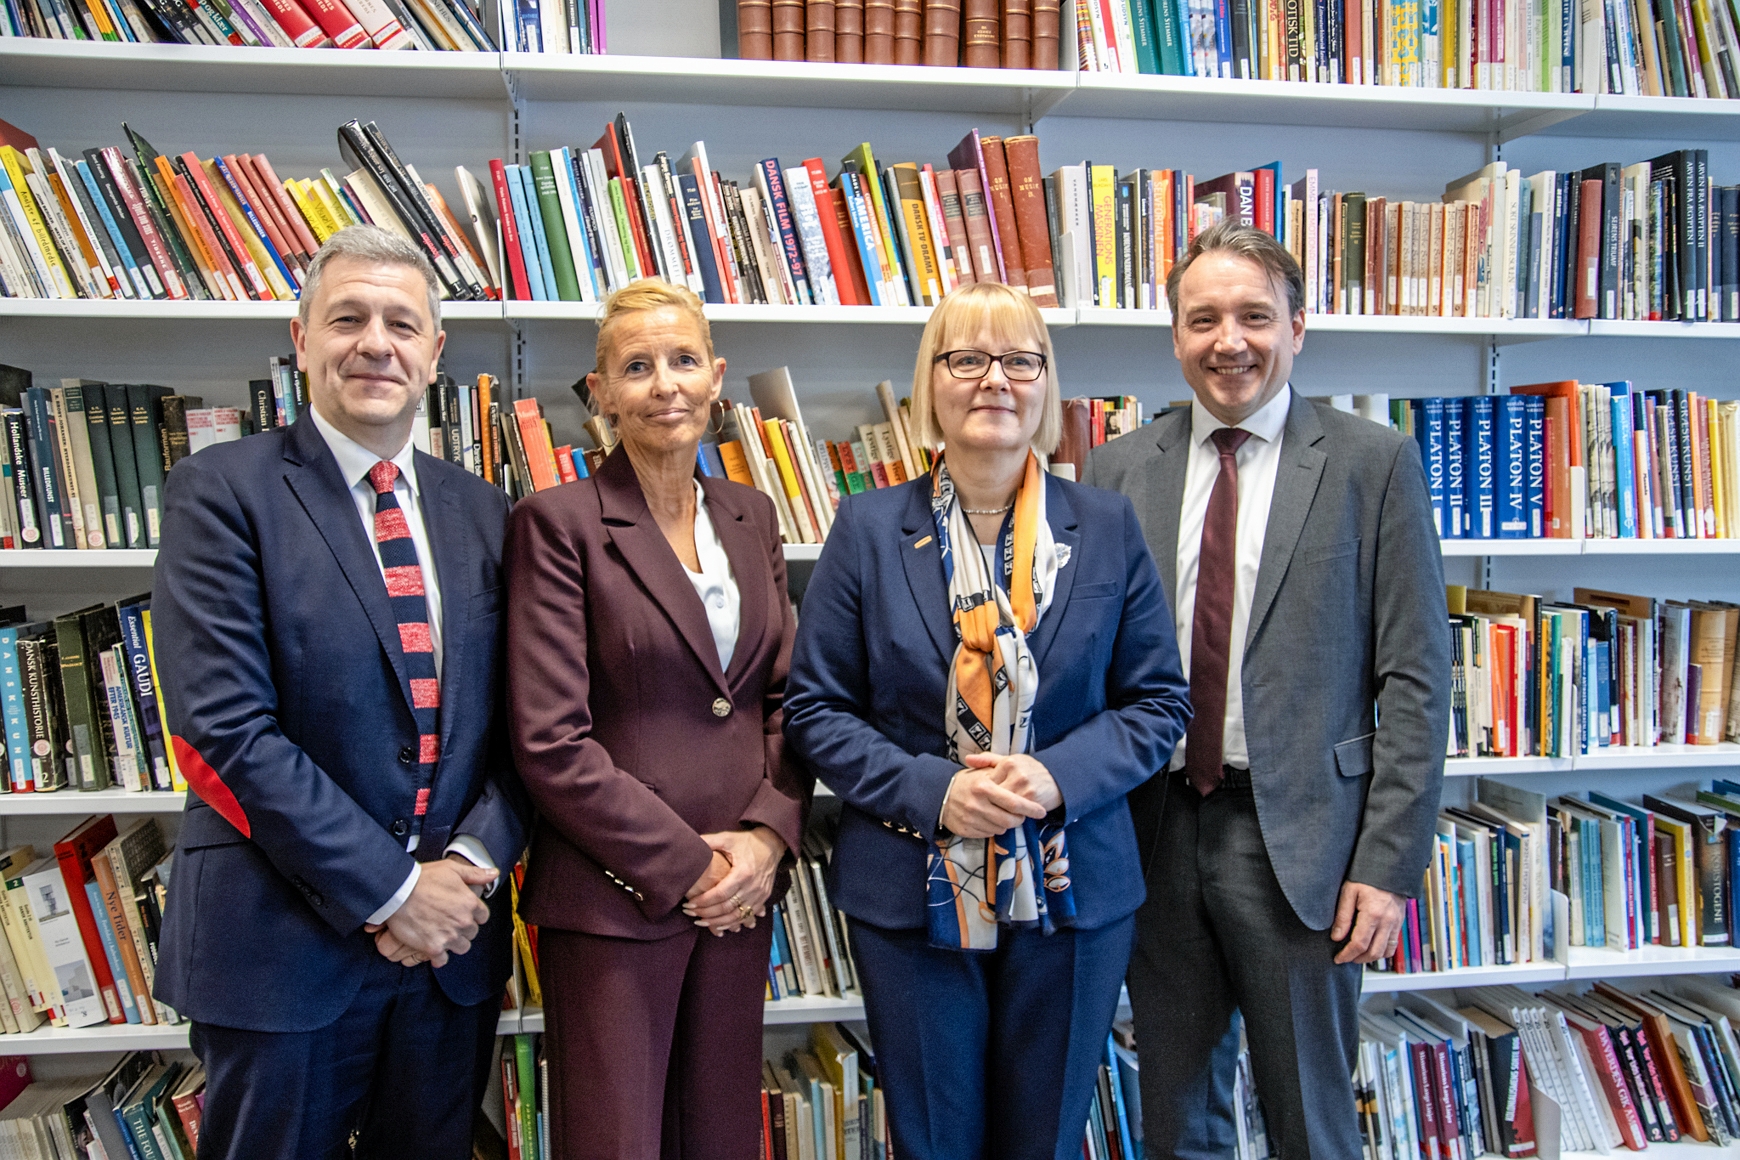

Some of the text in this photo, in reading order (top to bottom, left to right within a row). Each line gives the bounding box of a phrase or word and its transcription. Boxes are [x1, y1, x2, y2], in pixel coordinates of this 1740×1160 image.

[211, 11, 229, 32] klær
[1139, 17, 1147, 45] STEMMER
[1164, 17, 1172, 46] STEMMER
[765, 159, 783, 199] DANSK
[18, 190, 35, 215] Analyse
[775, 201, 791, 229] FILM
[875, 204, 891, 239] PODCAST
[911, 202, 924, 229] DANSK
[1153, 181, 1164, 240] SELVFORTALT
[1239, 186, 1252, 215] DAN
[853, 196, 876, 251] AMERICA
[1095, 204, 1103, 256] MASKINEN
[1103, 195, 1113, 264] GENERATIONS
[782, 232, 803, 276] 1972-97
[257, 390, 269, 426] Christian
[9, 421, 28, 498] Hollandske Museer
[451, 428, 461, 461] UDTRYK
[864, 431, 879, 461] Lystige
[880, 430, 895, 460] Lystige
[1429, 419, 1442, 489] PLATON
[1448, 419, 1462, 488] PLATON
[1478, 419, 1491, 488] PLATON
[1509, 416, 1522, 487] PLATON
[1529, 418, 1542, 488] PLATON
[1666, 399, 1679, 487] GRÆSK KUNST
[1680, 399, 1692, 488] GRÆSK KUNST
[42, 466, 54, 502] BILLEDKUNST
[127, 614, 141, 649] Essential
[1, 636, 16, 701] DANSK
[24, 641, 44, 738] DANSK KUNSTHISTORIE
[132, 652, 152, 697] GAUDI
[115, 685, 132, 749] AMERIKANSK KULTUR
[42, 772, 49, 783] 2
[104, 891, 127, 941] Nye Tider
[1601, 1043, 1623, 1088] VERDEN
[1616, 1087, 1630, 1107] GIK
[132, 1117, 148, 1140] THE
[1651, 1128, 1661, 1141] 2
[1668, 1129, 1678, 1141] 3
